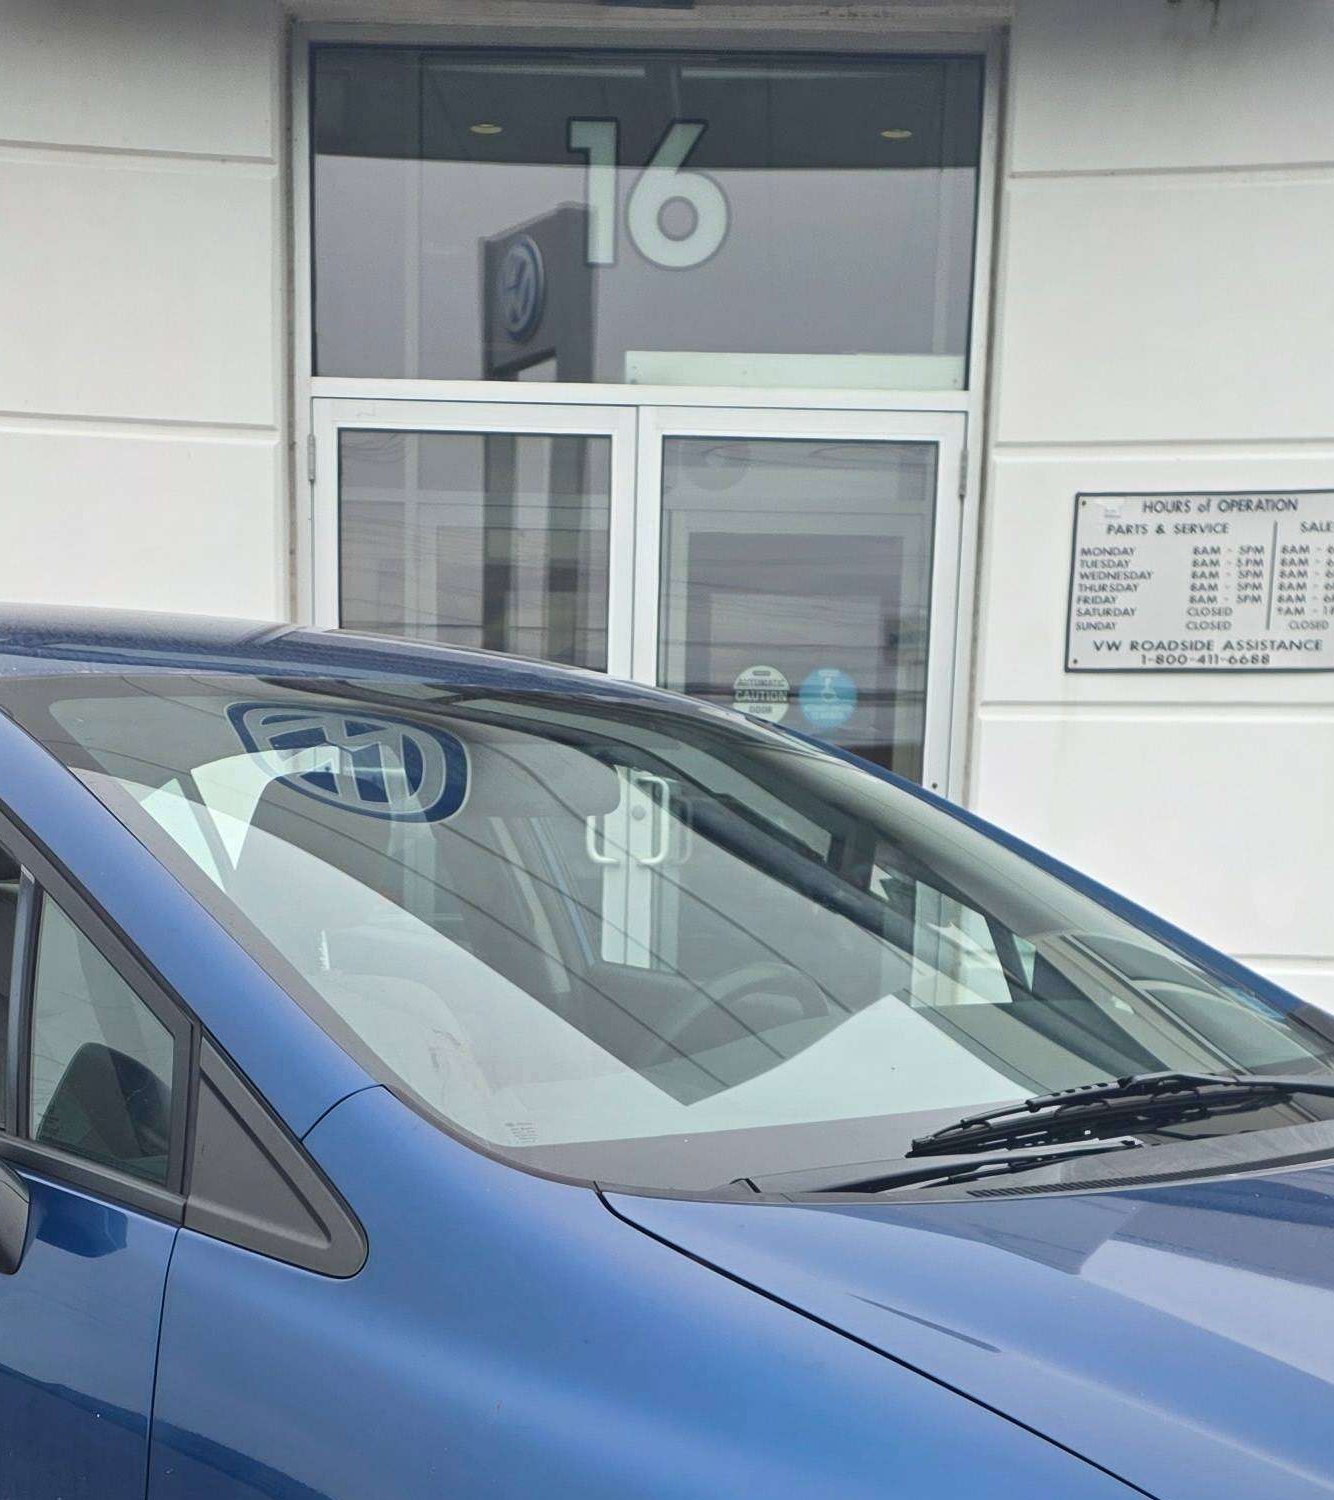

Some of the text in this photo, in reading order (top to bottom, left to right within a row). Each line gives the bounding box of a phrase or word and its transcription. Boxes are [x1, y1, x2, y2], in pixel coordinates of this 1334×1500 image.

[569, 119, 729, 269] 16
[1142, 498, 1298, 514] HOURS of OPERATION
[1107, 522, 1230, 535] PARTS & SERVICE
[1081, 547, 1136, 556] MONDAY
[1080, 559, 1131, 569] TUESDAY
[1080, 570, 1154, 580] WEDNESDAY
[1078, 583, 1139, 593] THURSDAY
[1077, 595, 1118, 605] FRIDAY
[1077, 606, 1233, 617] SATURDAY CLOSED
[1075, 621, 1232, 631] SUNDAY CLOSED
[1288, 620, 1329, 630] CLOSED
[1093, 638, 1324, 651] VW ROADSIDE ASSISTANCE
[1141, 653, 1271, 666] 1-800-411-6688
[734, 690, 788, 702] CAUTION
